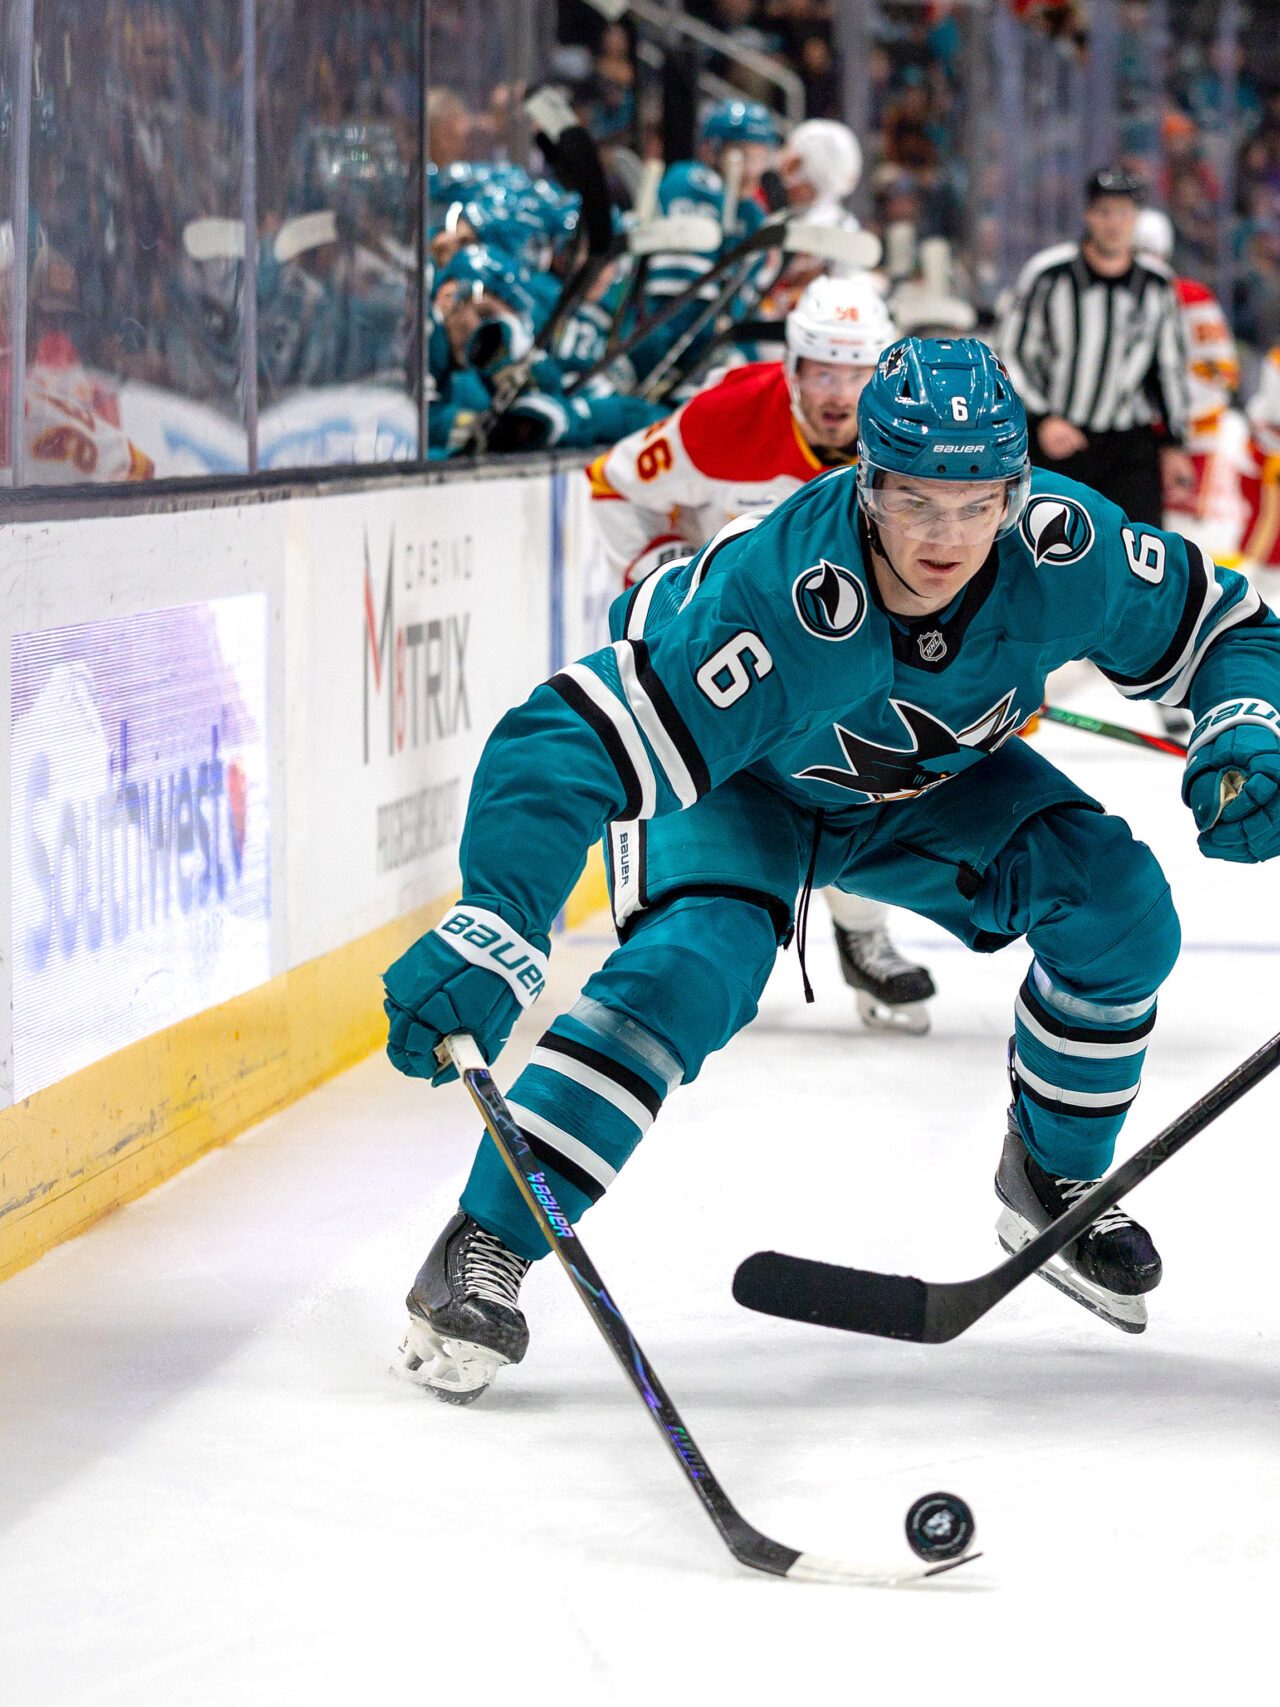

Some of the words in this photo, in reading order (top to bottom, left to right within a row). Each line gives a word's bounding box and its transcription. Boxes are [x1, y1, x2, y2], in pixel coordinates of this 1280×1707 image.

[951, 396, 969, 422] 6
[933, 444, 985, 453] BAUER
[1120, 527, 1167, 586] 6
[694, 629, 775, 710] 6
[619, 832, 630, 889] BAUER
[529, 1182, 575, 1238] BAUER
